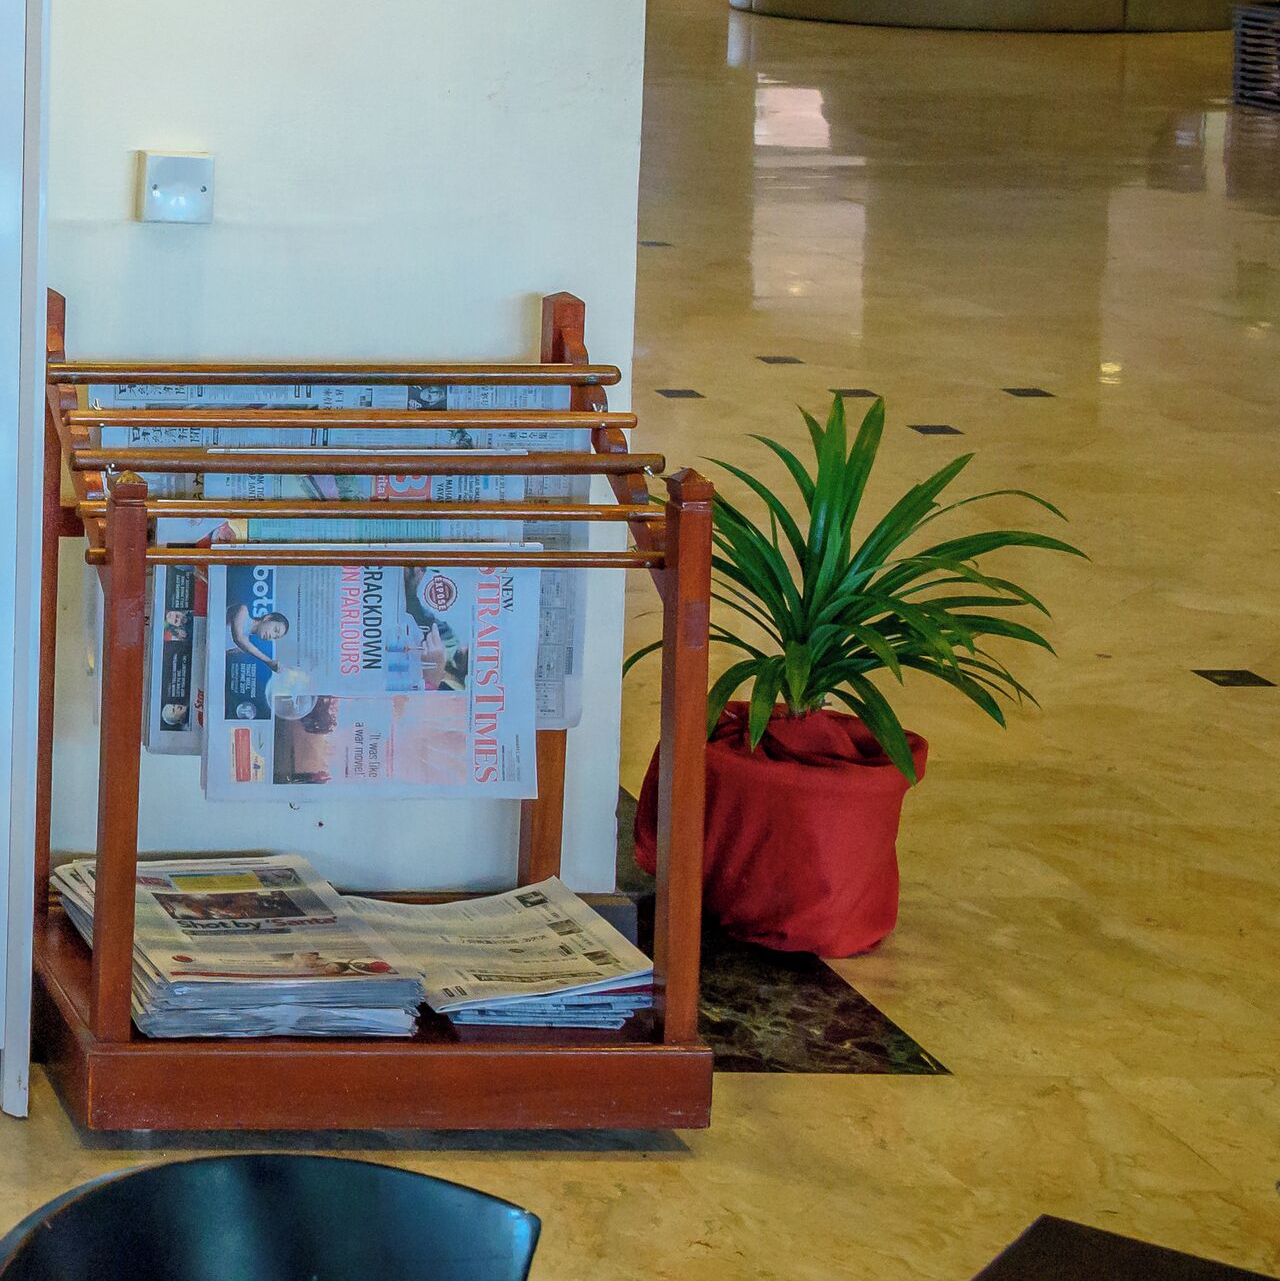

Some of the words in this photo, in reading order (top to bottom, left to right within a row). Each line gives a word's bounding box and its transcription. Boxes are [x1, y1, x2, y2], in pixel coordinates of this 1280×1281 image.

[432, 575, 448, 612] EXPOSE
[501, 576, 515, 613] NEW
[340, 587, 360, 675] PARLOURS
[354, 729, 363, 746] war
[473, 686, 506, 783] TIMES
[368, 743, 378, 760] was
[368, 760, 382, 778] like
[176, 920, 225, 930] Shot
[230, 919, 261, 931] by
